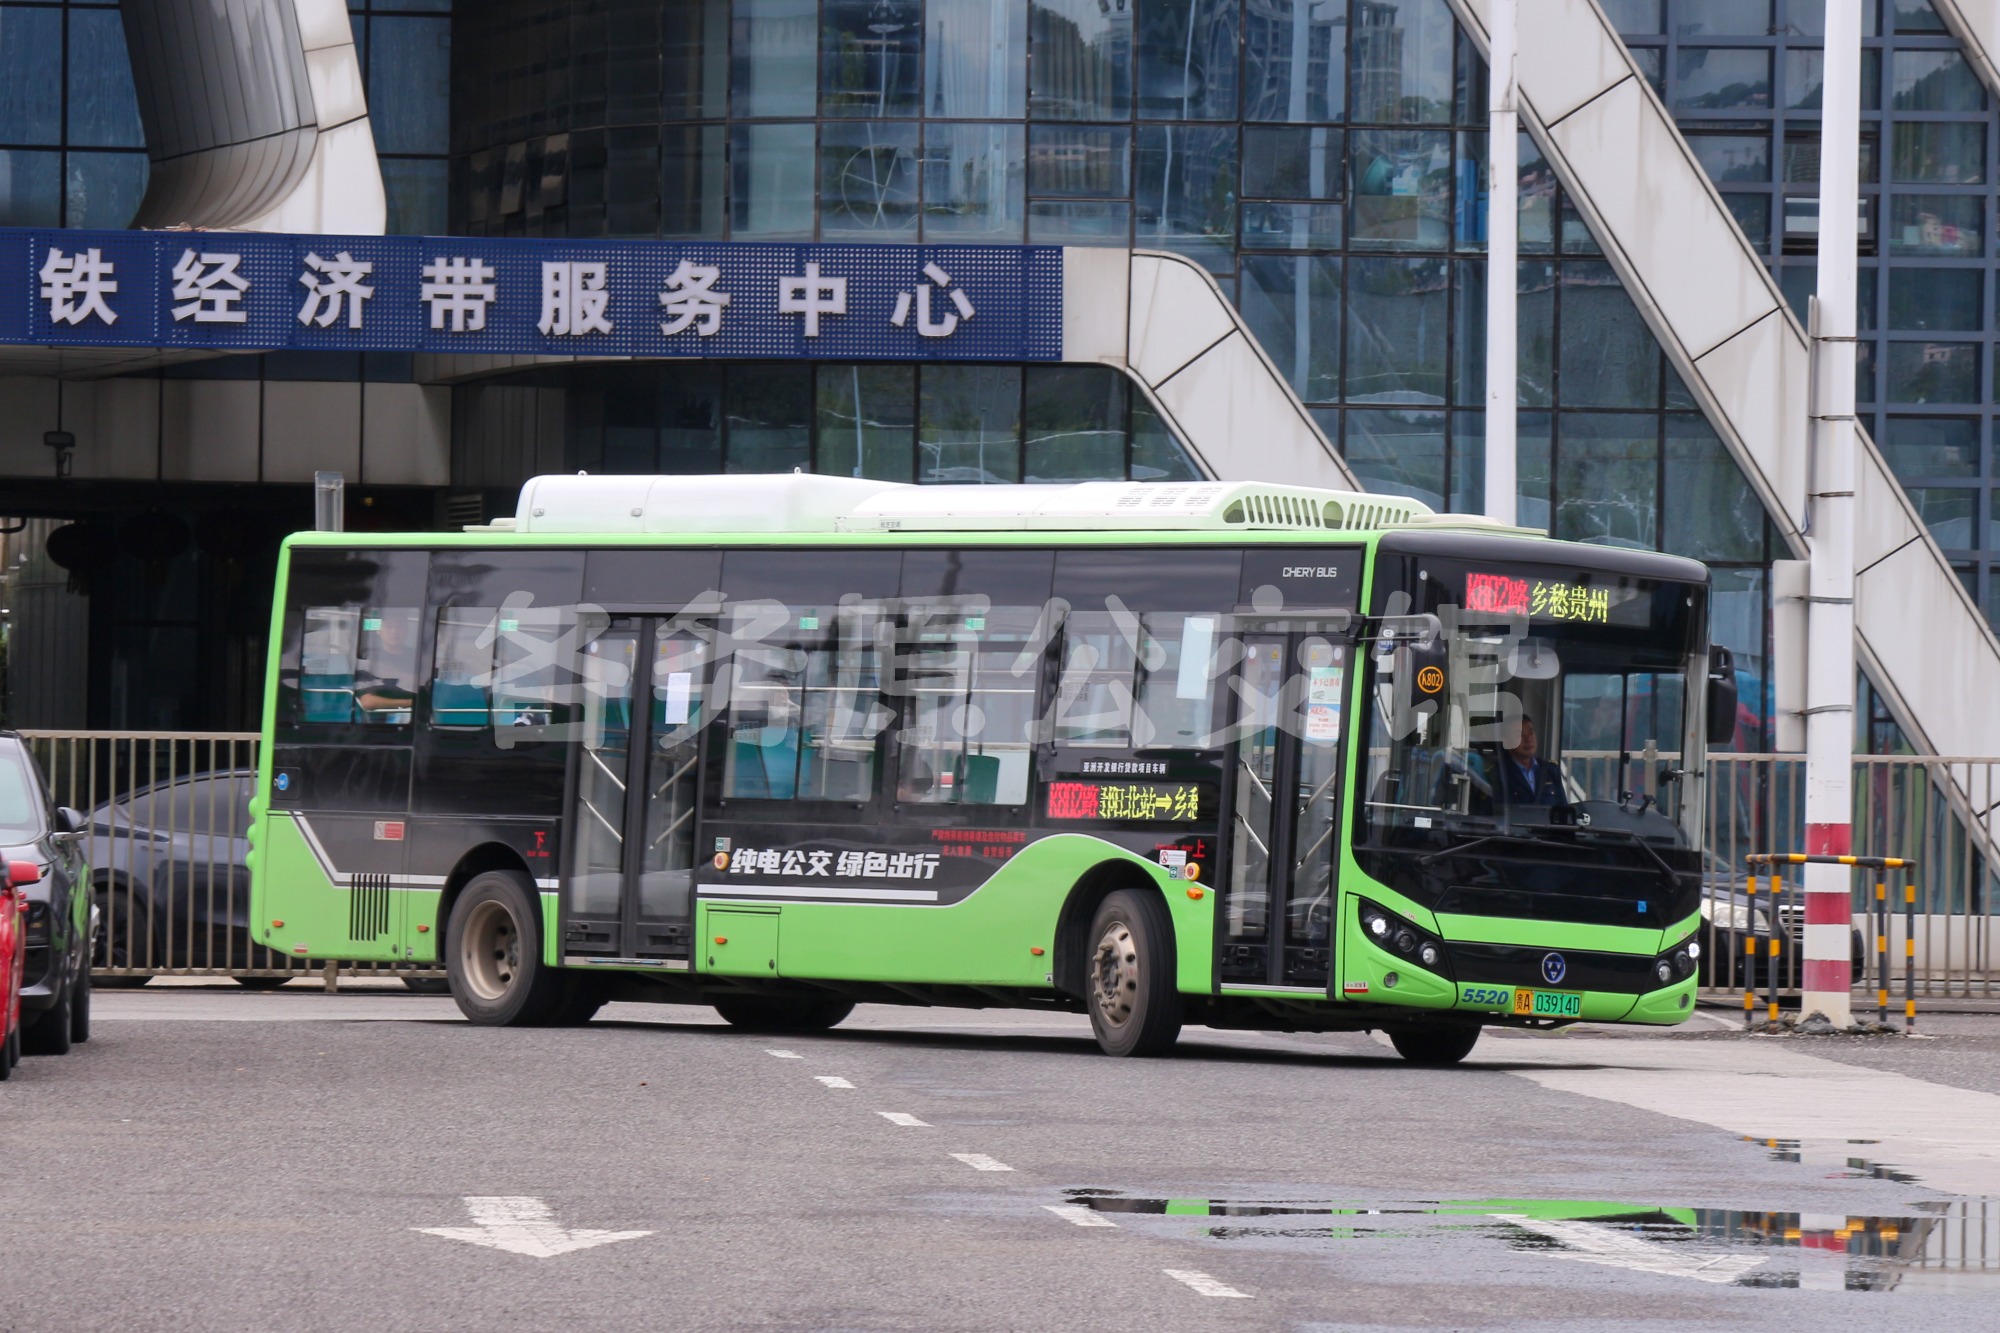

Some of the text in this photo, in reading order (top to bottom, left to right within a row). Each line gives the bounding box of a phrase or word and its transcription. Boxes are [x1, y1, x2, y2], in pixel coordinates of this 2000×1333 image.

[38, 247, 976, 337] 铁经济带服务中心
[1282, 566, 1338, 578] CHERY BUS
[1466, 572, 1610, 623] K802路 乡愁贵州
[1082, 761, 1167, 775] 亚洲开发银行贷款项目车辆
[534, 831, 546, 849] 下
[1192, 839, 1206, 859] 上
[730, 847, 940, 880] 纯电公交 绿色出行
[1462, 988, 1509, 1005] 5520
